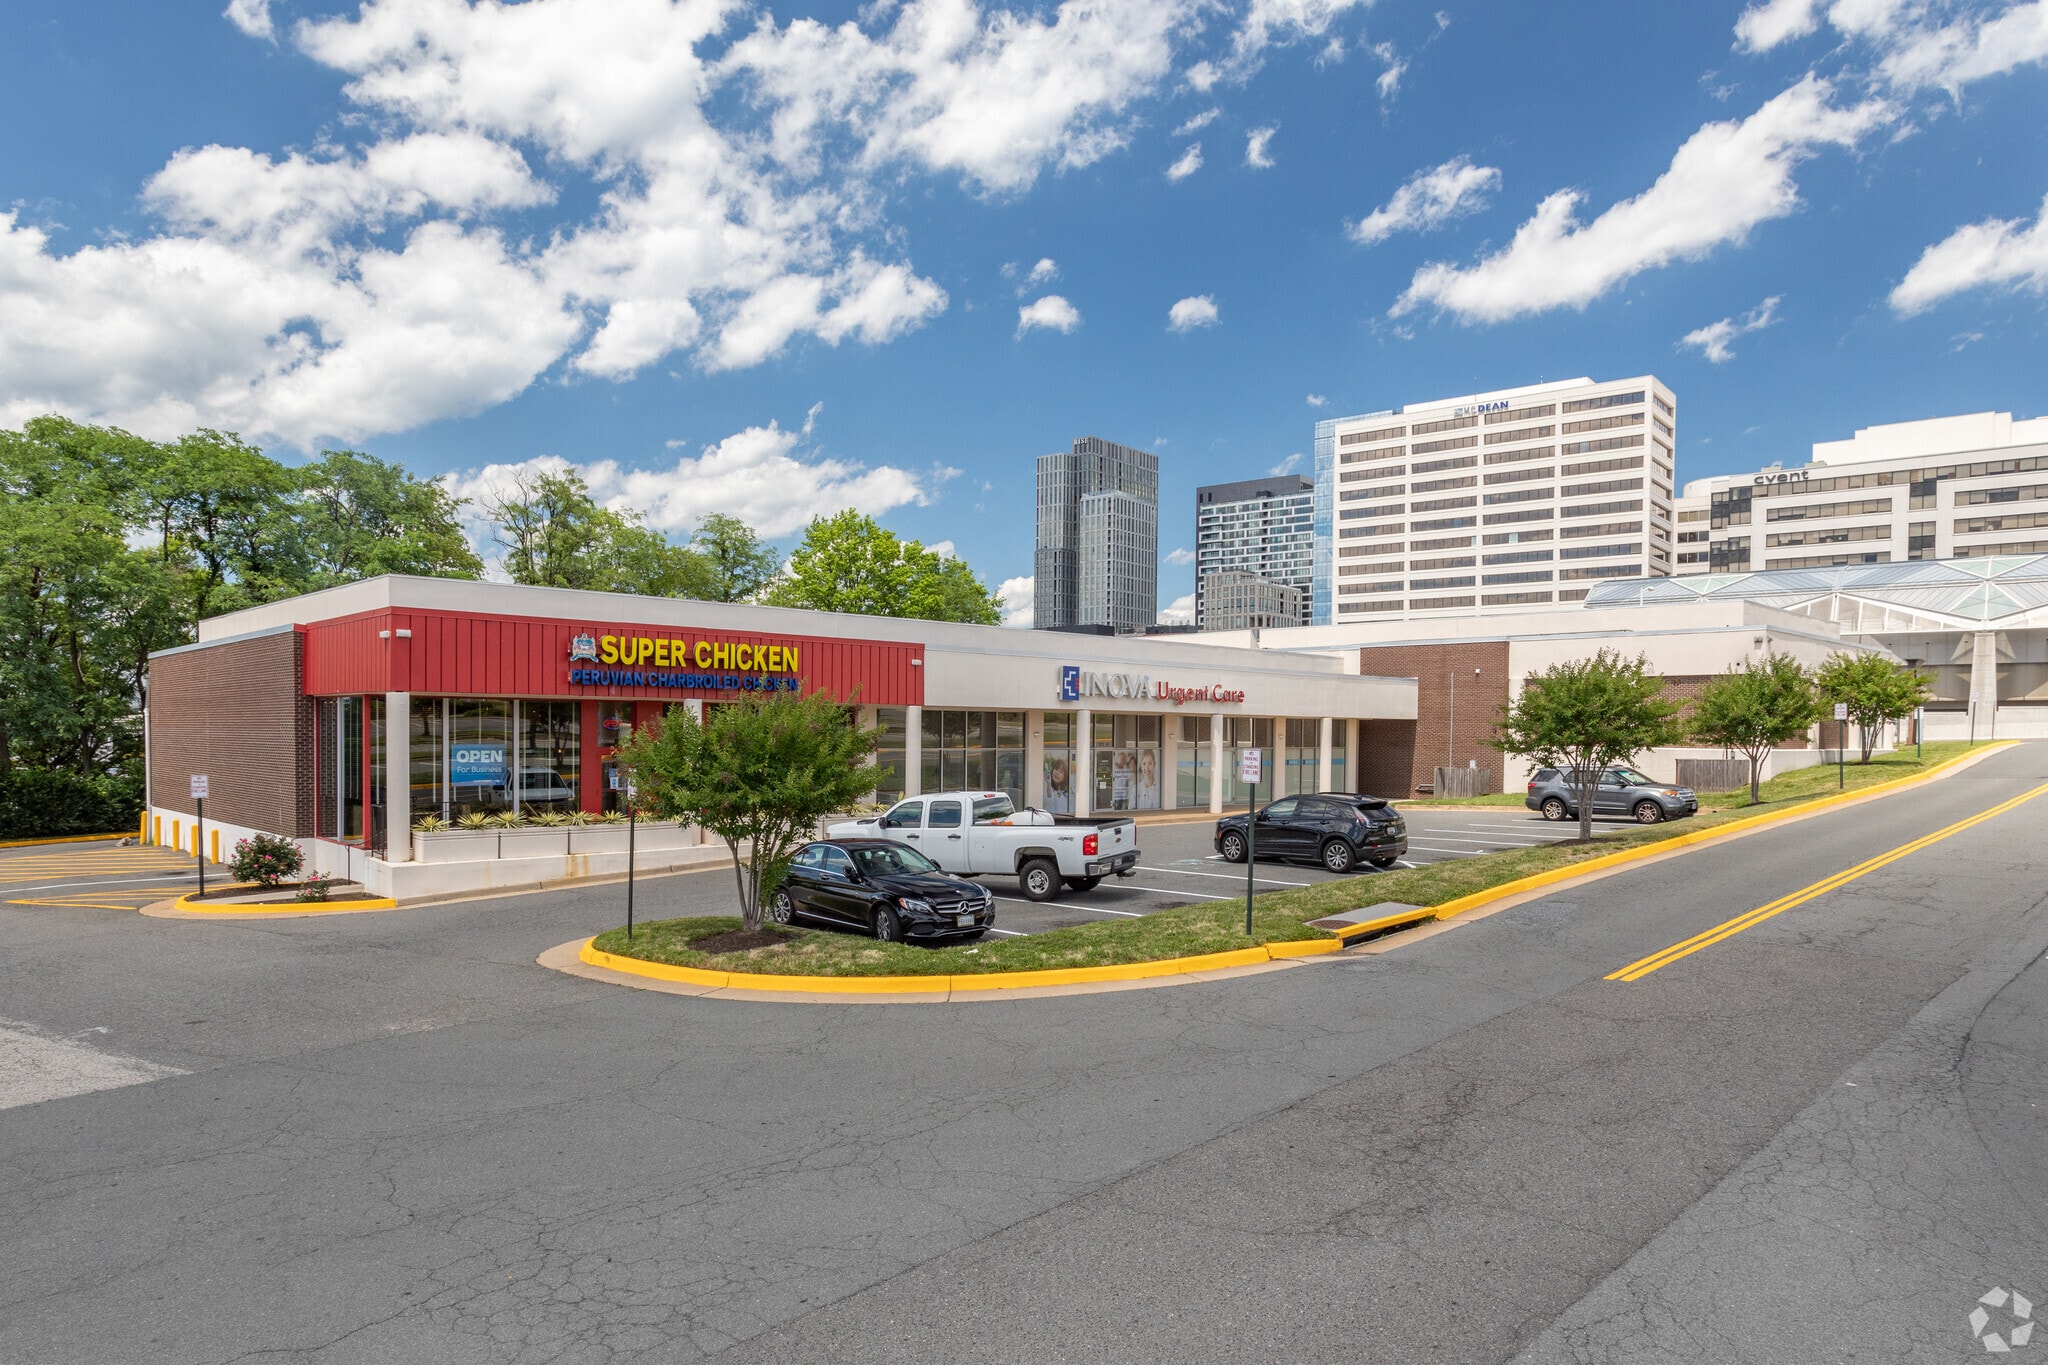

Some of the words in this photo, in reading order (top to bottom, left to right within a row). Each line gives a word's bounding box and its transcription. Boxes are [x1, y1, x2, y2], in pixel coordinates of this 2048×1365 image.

[1478, 401, 1508, 412] DEAN
[1754, 470, 1809, 484] cvent
[600, 635, 686, 667] SUPER
[694, 640, 798, 672] CHICKEN
[571, 669, 645, 687] PERUVIAN
[647, 672, 740, 691] CHARBROILED
[1083, 672, 1151, 699] INOVA
[1157, 681, 1208, 705] Urgent
[1212, 683, 1245, 703] Care
[456, 750, 503, 763] OPEN
[471, 765, 502, 773] Business
